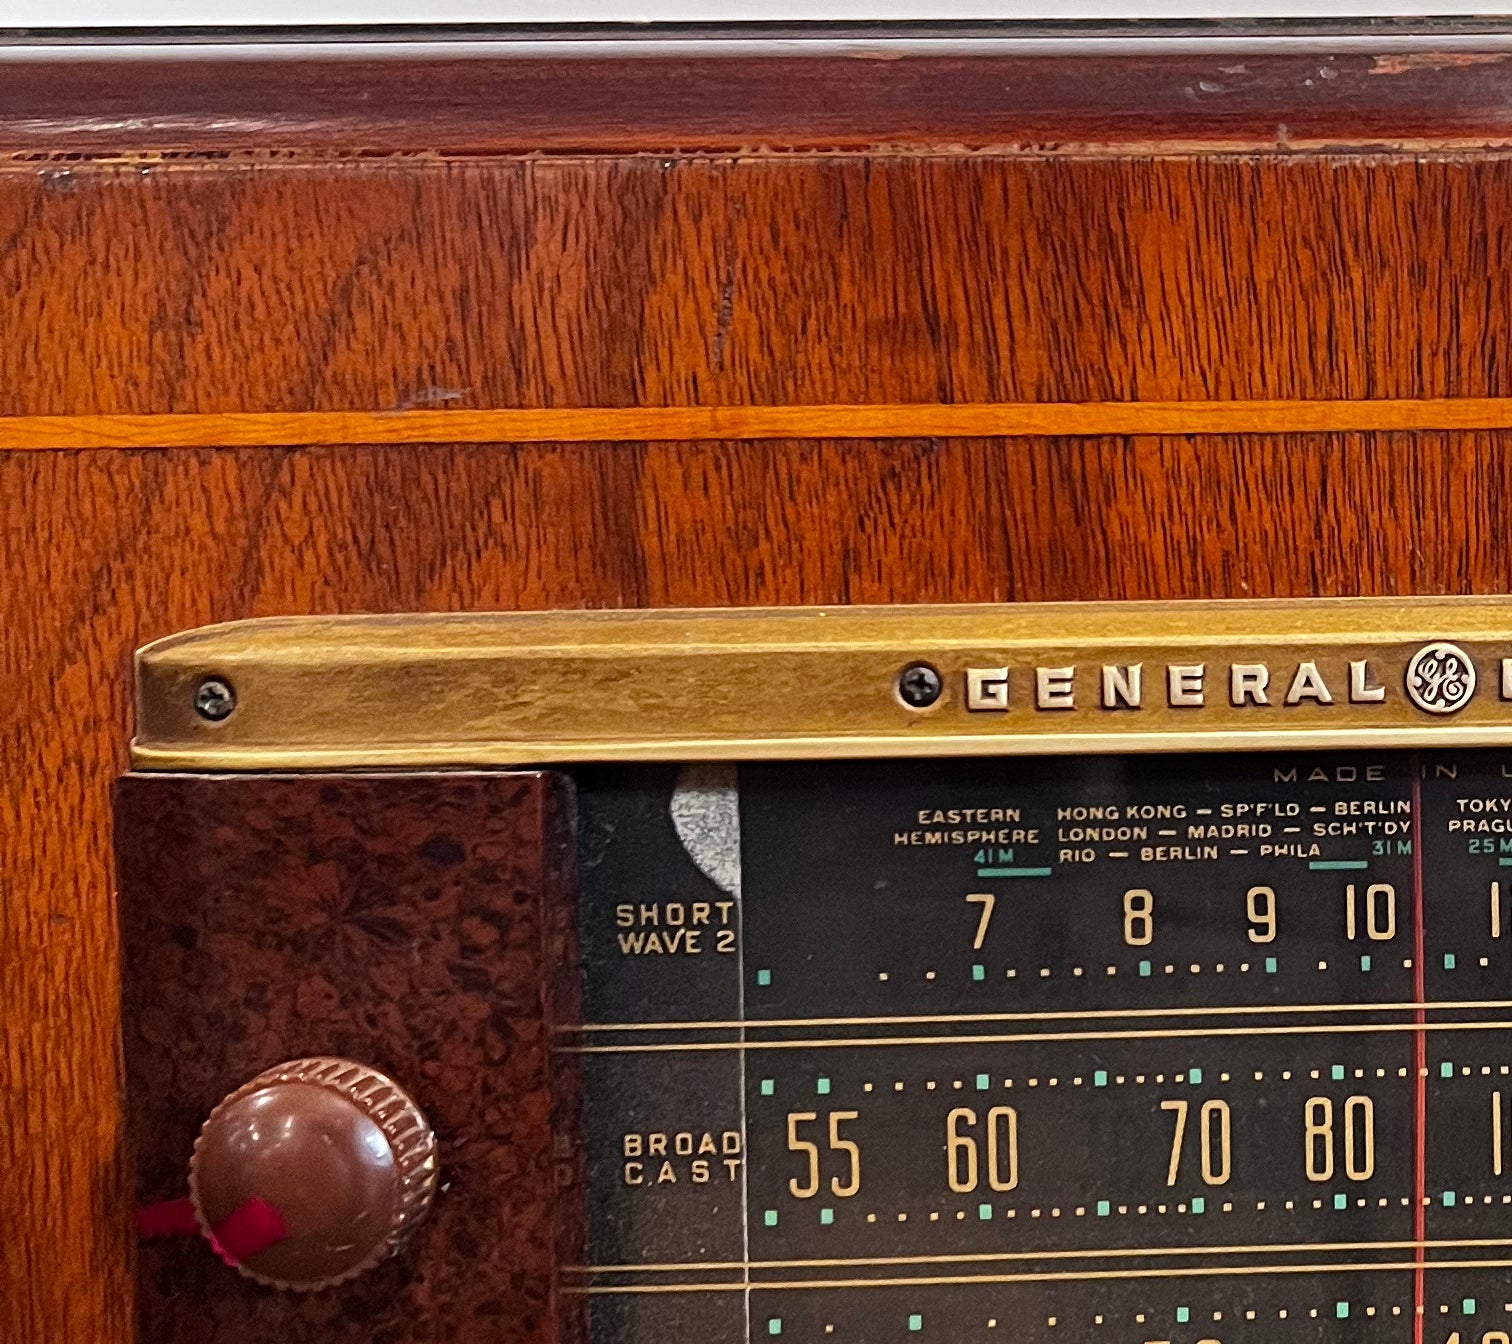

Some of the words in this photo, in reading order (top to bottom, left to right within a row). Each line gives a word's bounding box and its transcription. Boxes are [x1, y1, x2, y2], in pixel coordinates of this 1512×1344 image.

[965, 660, 1387, 710] GENERAL
[1274, 765, 1386, 782] MADE
[1421, 763, 1458, 780] IN
[918, 808, 1021, 825] EASTERN
[1057, 807, 1120, 821] HONG
[1126, 805, 1188, 820] KONG
[1334, 800, 1412, 816] BERLIN
[894, 828, 1040, 846] HEMISPHERE
[1058, 826, 1148, 843] LONDON
[1187, 824, 1273, 840] MADRID
[1059, 849, 1096, 864] RIO
[1140, 845, 1219, 861] BERLIN
[1259, 842, 1321, 858] PHILA
[616, 901, 734, 927] SHORT
[965, 894, 995, 951] 7
[1123, 888, 1155, 947] 8
[1247, 886, 1277, 943] 9
[1346, 883, 1396, 942] 10
[617, 927, 702, 955] WAVE
[716, 929, 737, 953] 2
[623, 1131, 741, 1157] BROAD
[946, 1106, 1019, 1193] 60
[1160, 1098, 1232, 1187] 70
[1304, 1095, 1376, 1183] 80
[787, 1111, 861, 1198] 55
[624, 1159, 741, 1186] CAST
